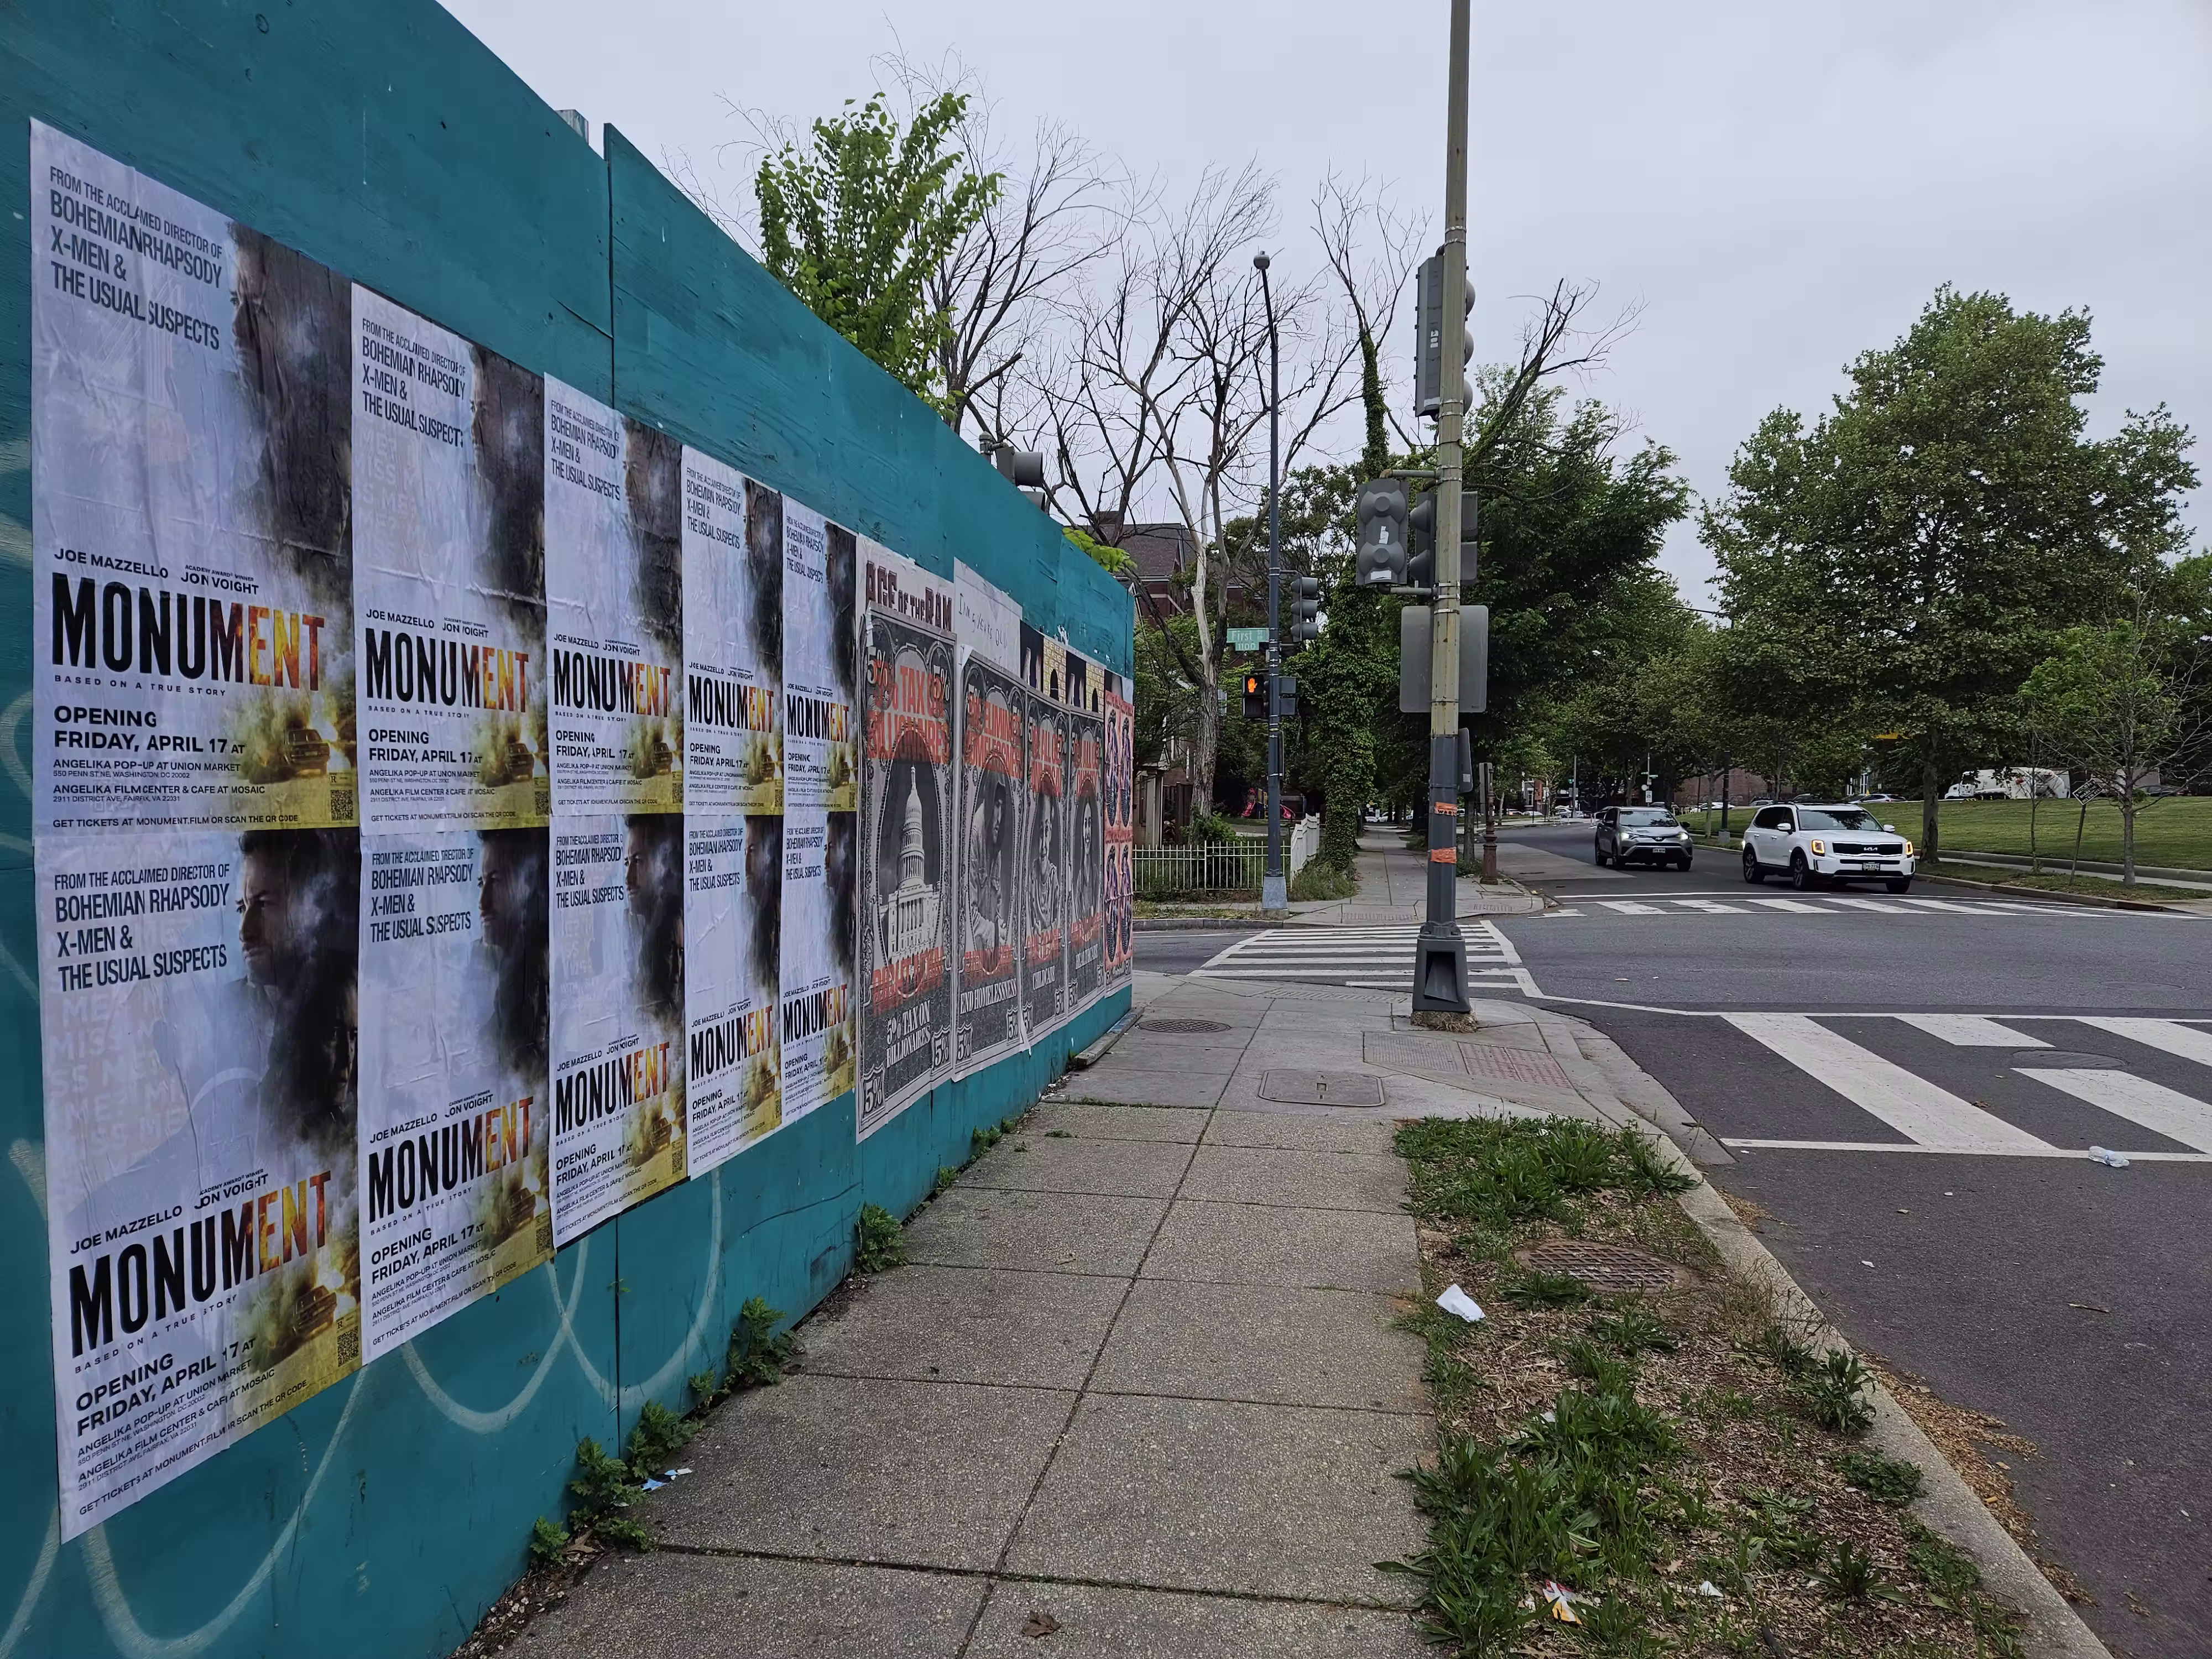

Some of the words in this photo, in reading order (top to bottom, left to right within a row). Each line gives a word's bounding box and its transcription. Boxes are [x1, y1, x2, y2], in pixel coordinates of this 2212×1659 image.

[51, 166, 81, 195] FROM
[84, 182, 103, 205] THE
[165, 221, 208, 253] DIRECTOR
[211, 243, 221, 259] OF
[51, 226, 108, 274] X-MEN
[114, 254, 126, 281] &
[142, 232, 221, 288] RHAPSODY
[51, 261, 84, 299] THE
[90, 276, 145, 321] USUAL
[149, 301, 218, 349] SUSPECTS
[363, 364, 397, 396] X-MEN
[400, 380, 406, 400] &
[363, 391, 382, 417] THE
[385, 400, 417, 431] USUAL
[551, 436, 573, 461] X-MEN
[55, 549, 86, 564] JOE
[92, 554, 168, 578] MAZZELLO
[212, 577, 258, 594] VOIGHT
[865, 560, 897, 611] AGE
[898, 589, 909, 614] OF
[910, 595, 925, 621] THE
[925, 587, 952, 632] RAM
[52, 573, 324, 690] MONUMENT
[388, 612, 434, 628] MAZZELLO
[1232, 630, 1252, 641] First
[55, 675, 100, 685] BASED
[151, 684, 180, 692] TRUE
[366, 628, 529, 712] MONUMENT
[554, 649, 671, 717] MONUMENT
[688, 674, 774, 733] MONUMENT
[900, 665, 925, 715] TAX
[55, 706, 156, 727] OPENING
[786, 693, 849, 743] MONUMENT
[55, 730, 138, 752] FRIDAY,
[147, 735, 203, 752] APRIL
[210, 739, 227, 753] 17
[232, 744, 245, 753] AT
[369, 729, 428, 744] OPENING
[556, 745, 589, 758] FRIDAY,
[690, 743, 720, 754] OPENING
[53, 759, 111, 769] ANGELIKA
[114, 761, 154, 769] POP-UP
[170, 762, 201, 770] UNION
[204, 763, 241, 771] MARKET
[369, 748, 418, 763] FRIDAY,
[421, 750, 456, 763] APRIL
[716, 758, 735, 767] APRIL
[788, 764, 806, 773] FRIDAY,
[53, 785, 111, 794] ANGELIKA
[114, 785, 140, 794] FILM
[143, 785, 180, 794] CENTER
[55, 874, 85, 889] FROM
[89, 872, 108, 886] THE
[111, 868, 168, 885] ACCLAIMED
[171, 865, 215, 880] DIRECTOR
[218, 864, 229, 877] OF
[372, 868, 424, 889] BOHEMIAN
[56, 891, 144, 922] BOHEMIAN
[150, 884, 228, 912] RHAPSODY
[371, 894, 405, 916] X-MEN
[408, 894, 414, 912] &
[556, 892, 568, 908] THE
[570, 889, 591, 906] USUAL
[592, 885, 623, 904] SUSPECTS
[58, 927, 114, 957] X-MEN
[121, 925, 132, 949] &
[371, 922, 390, 942] THE
[393, 918, 424, 939] USUAL
[59, 963, 92, 991] THE
[97, 956, 150, 985] USUAL
[154, 945, 226, 977] SUSPECTS
[1033, 966, 1055, 990] CHILDCARE
[783, 983, 848, 1044] MONUMENT
[960, 992, 974, 1014] END
[974, 978, 1016, 1010] HOMELESSNESS
[887, 1018, 901, 1045] 5%
[902, 1006, 919, 1033] TAX
[919, 1000, 930, 1027] ON
[691, 1005, 773, 1081] MONUMENT
[785, 1053, 807, 1069] OPENING
[886, 1025, 931, 1068] BILLIONAIRES
[935, 1035, 949, 1066] 5%
[958, 1035, 970, 1060] 5%
[555, 1042, 670, 1135] MONUMENT
[692, 1089, 722, 1109] OPENING
[865, 1077, 882, 1113] 5%
[391, 1113, 437, 1136] MAZZELLO
[692, 1104, 716, 1123] FRIDAY,
[369, 1097, 534, 1221] MONUMENT
[556, 1144, 596, 1170] OPENING
[556, 1162, 588, 1186] FRIDAY,
[591, 1150, 614, 1169] APRIL
[71, 1234, 101, 1254] JOE
[106, 1206, 181, 1241] MAZZELLO
[372, 1228, 431, 1264] OPENING
[70, 1171, 331, 1355] MONUMENT
[372, 1251, 419, 1284] FRIDAY,
[423, 1234, 457, 1259] APRIL
[461, 1224, 474, 1239] 17
[77, 1354, 173, 1411] OPENING
[78, 1384, 155, 1436] FRIDAY,
[161, 1356, 216, 1394] APRIL
[242, 1337, 255, 1352] AT
[79, 1447, 132, 1482] ANGELIKA
[242, 1369, 274, 1392] MOSAIC
